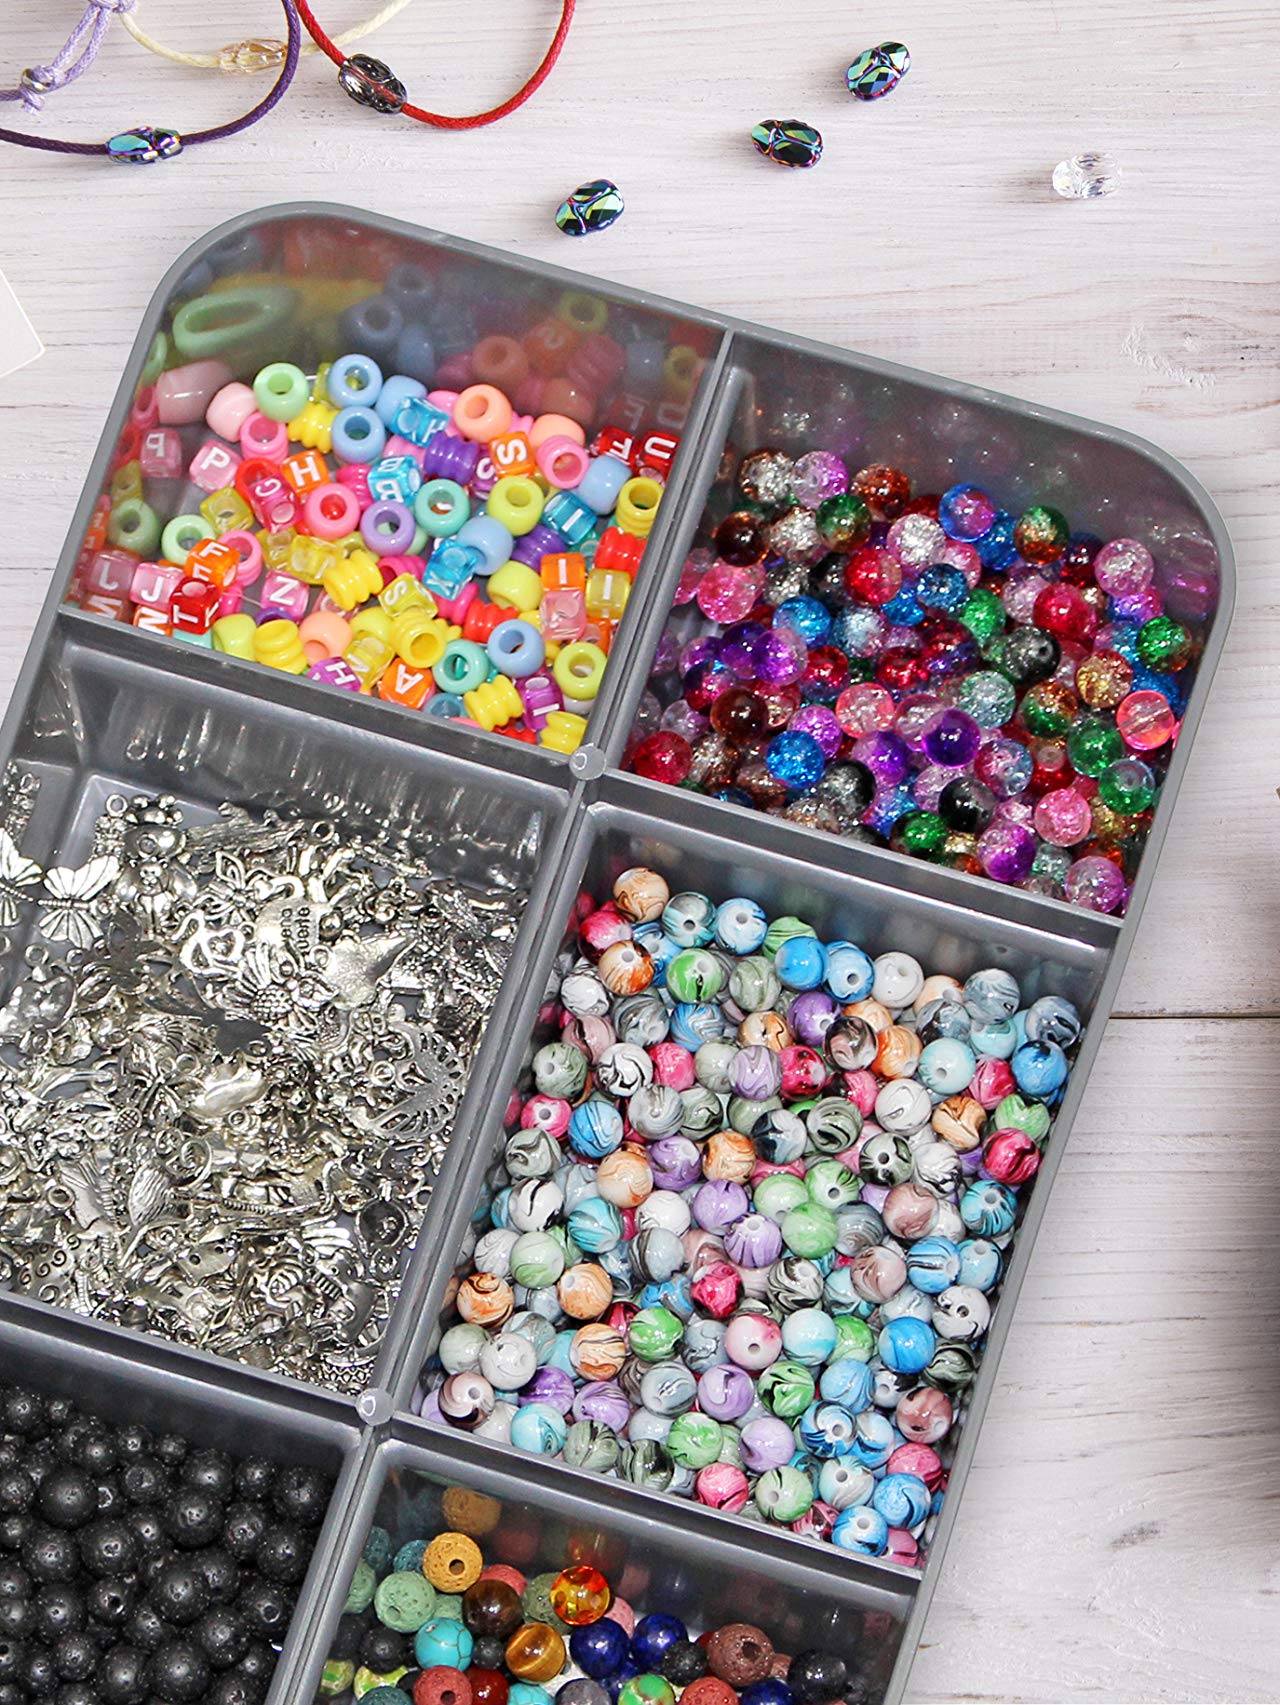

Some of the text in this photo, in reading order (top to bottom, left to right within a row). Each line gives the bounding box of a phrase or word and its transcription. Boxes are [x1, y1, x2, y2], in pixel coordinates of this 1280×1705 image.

[200, 446, 231, 471] P
[496, 439, 528, 466] S
[290, 456, 321, 487] H
[200, 542, 230, 559] F
[141, 576, 164, 602] J
[384, 580, 408, 606] S
[172, 604, 199, 625] T
[325, 661, 357, 686] H
[395, 663, 425, 695] A
[295, 907, 310, 951] uerte
